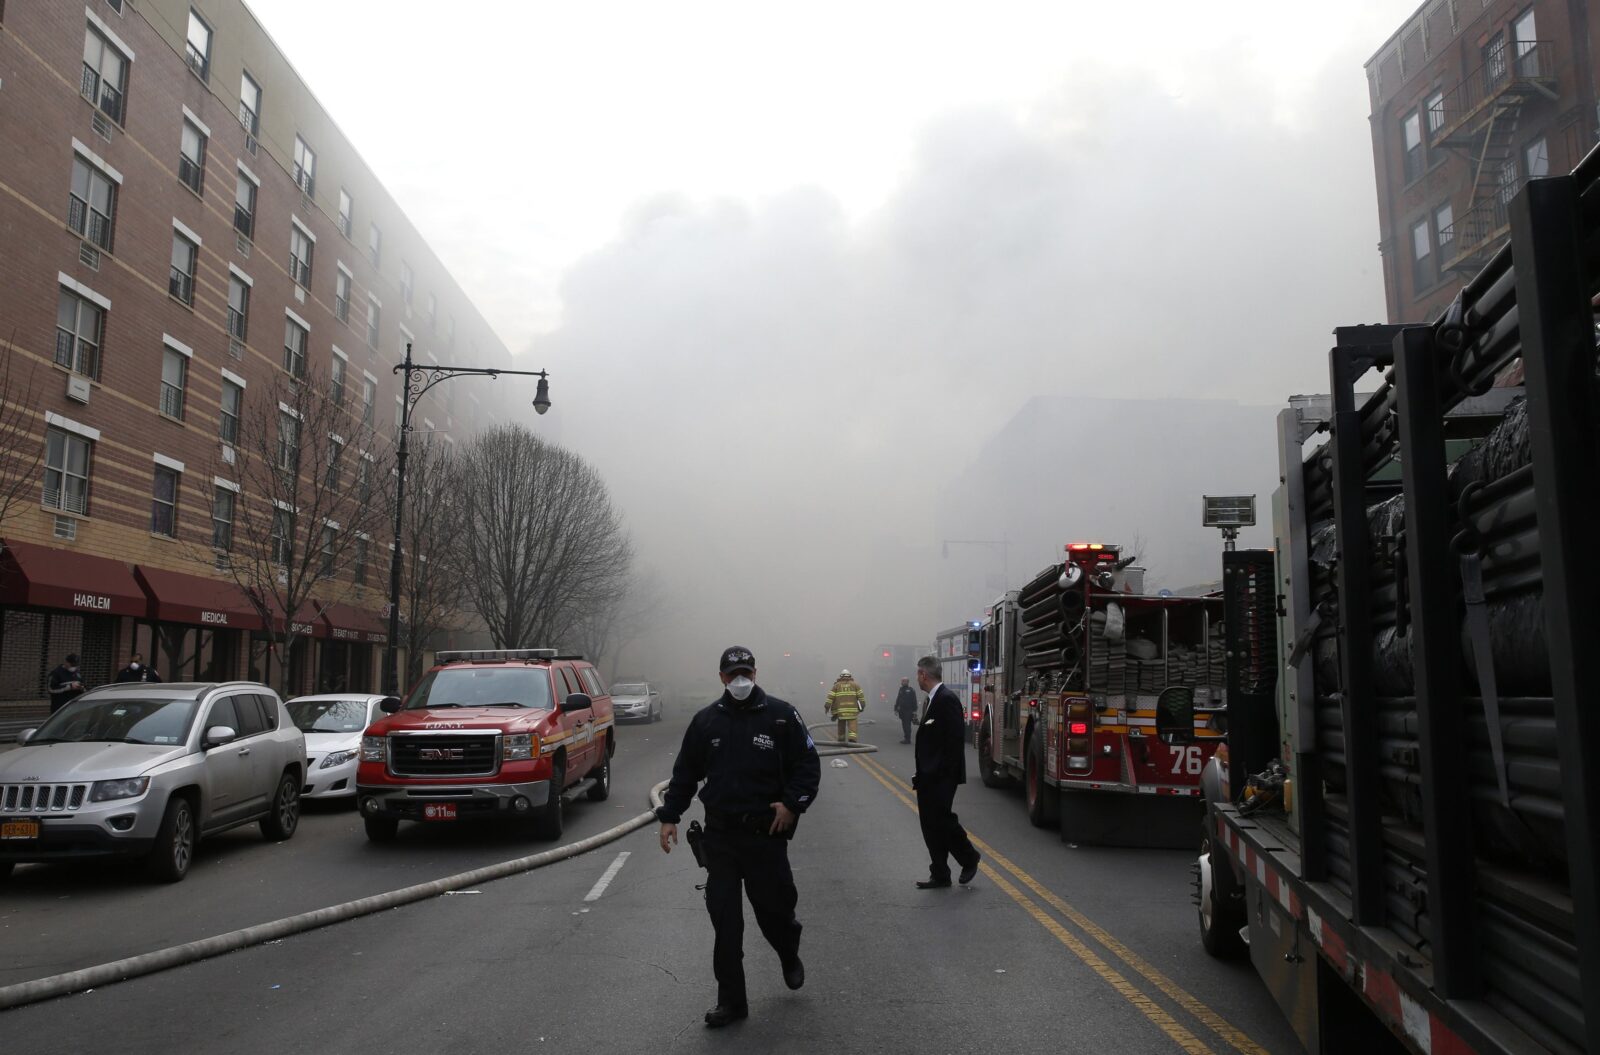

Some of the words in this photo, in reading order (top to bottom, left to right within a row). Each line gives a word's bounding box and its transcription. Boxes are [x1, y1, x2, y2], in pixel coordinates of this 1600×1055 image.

[73, 593, 111, 610] HARLEM
[201, 611, 228, 625] MEDICAL
[338, 628, 348, 639] EAST
[753, 736, 774, 747] POLICE
[420, 748, 464, 760] GMC
[1169, 745, 1202, 775] 76
[435, 806, 447, 818] 11
